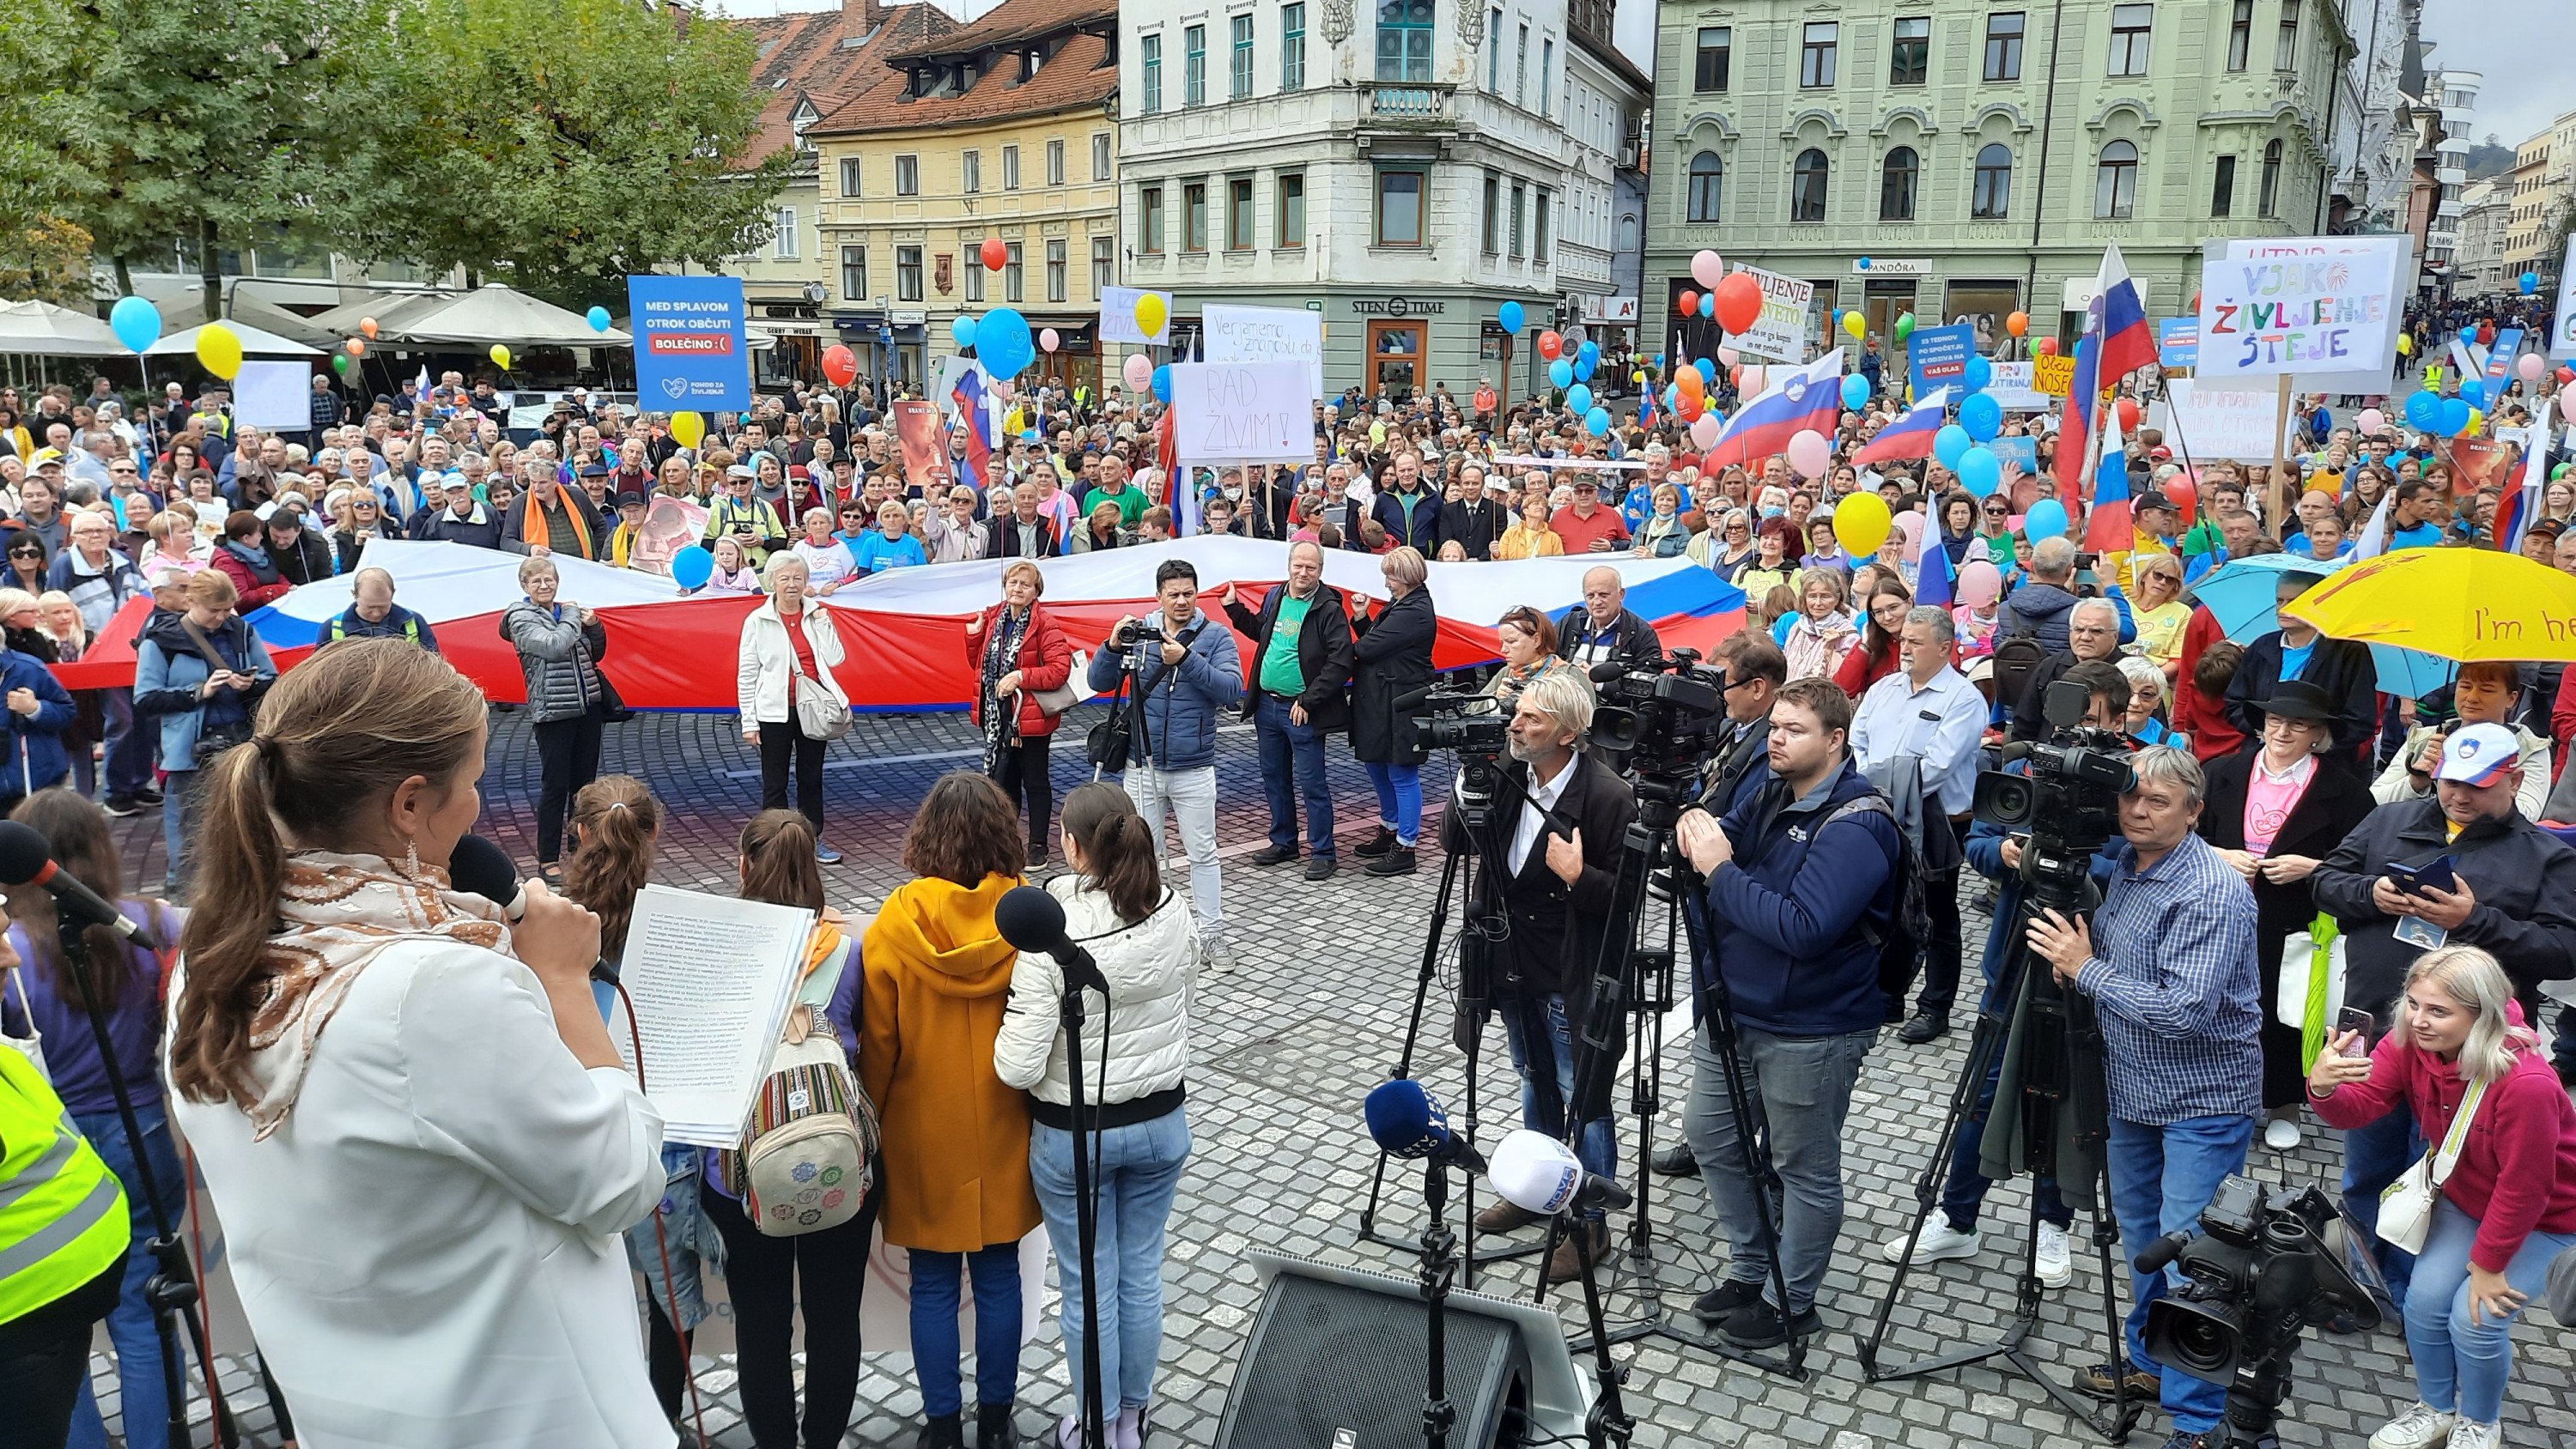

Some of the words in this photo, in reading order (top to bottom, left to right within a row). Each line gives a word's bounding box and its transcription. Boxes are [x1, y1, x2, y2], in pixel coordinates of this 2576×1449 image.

[646, 301, 671, 311] MED
[673, 302, 728, 312] SPLAVOM
[1352, 301, 1386, 313] STEN
[1412, 301, 1444, 313] TIME
[2211, 294, 2385, 333] ŽIVLJENJE
[646, 318, 685, 329] OTROK
[688, 318, 731, 329] OBČUTI
[655, 337, 713, 349] BOLEČINO
[1930, 335, 1958, 343] TEDNOV
[1929, 343, 1964, 353] SPOČETJU
[2239, 330, 2350, 367] ŠTEJE
[1207, 369, 1258, 407] RAD
[1204, 409, 1272, 452] ŽIVIM
[2476, 606, 2522, 640] I'm
[1403, 1134, 1431, 1155] RTV
